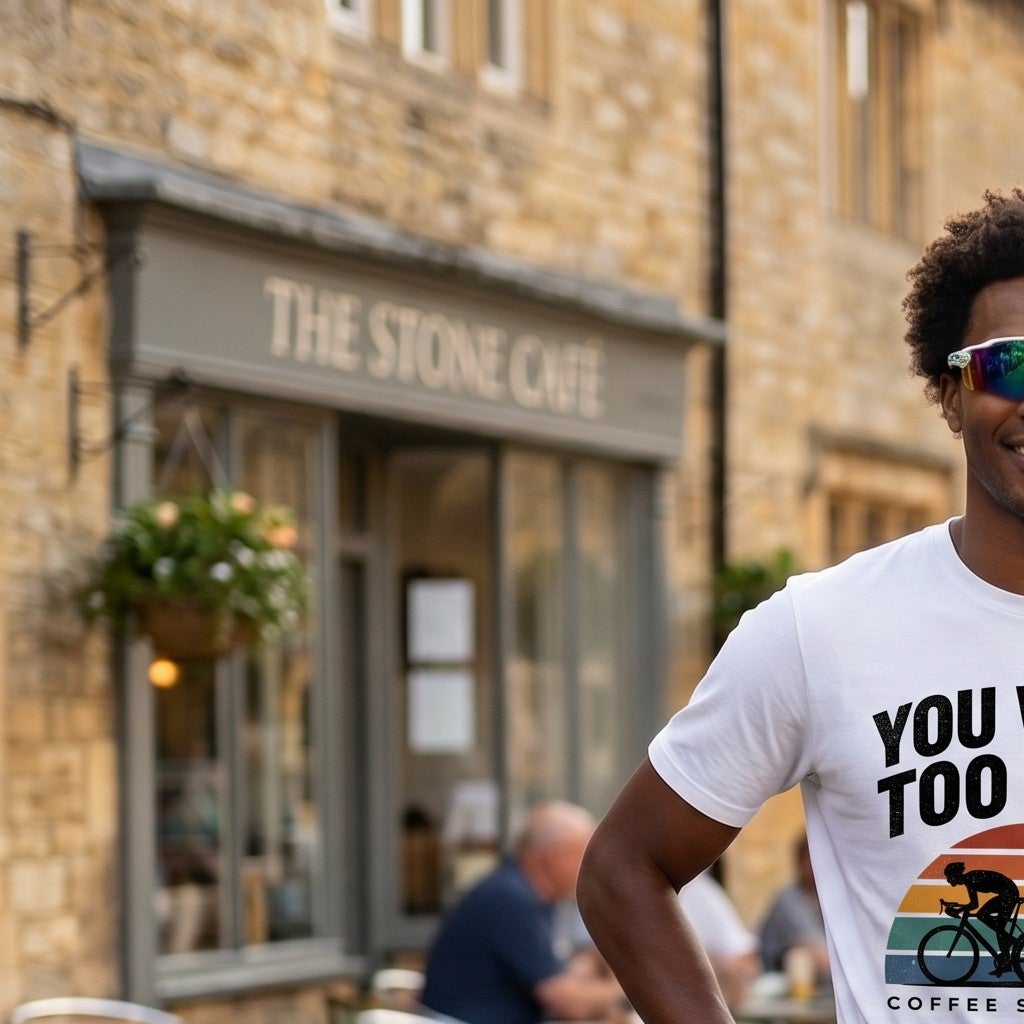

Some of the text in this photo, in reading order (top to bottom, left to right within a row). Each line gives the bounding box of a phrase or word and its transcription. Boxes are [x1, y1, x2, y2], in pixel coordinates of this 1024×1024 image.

[265, 278, 360, 371] THE
[368, 303, 502, 398] STONE
[873, 687, 996, 768] YOU
[877, 754, 1007, 838] TOO
[886, 996, 998, 1012] COFFEE
